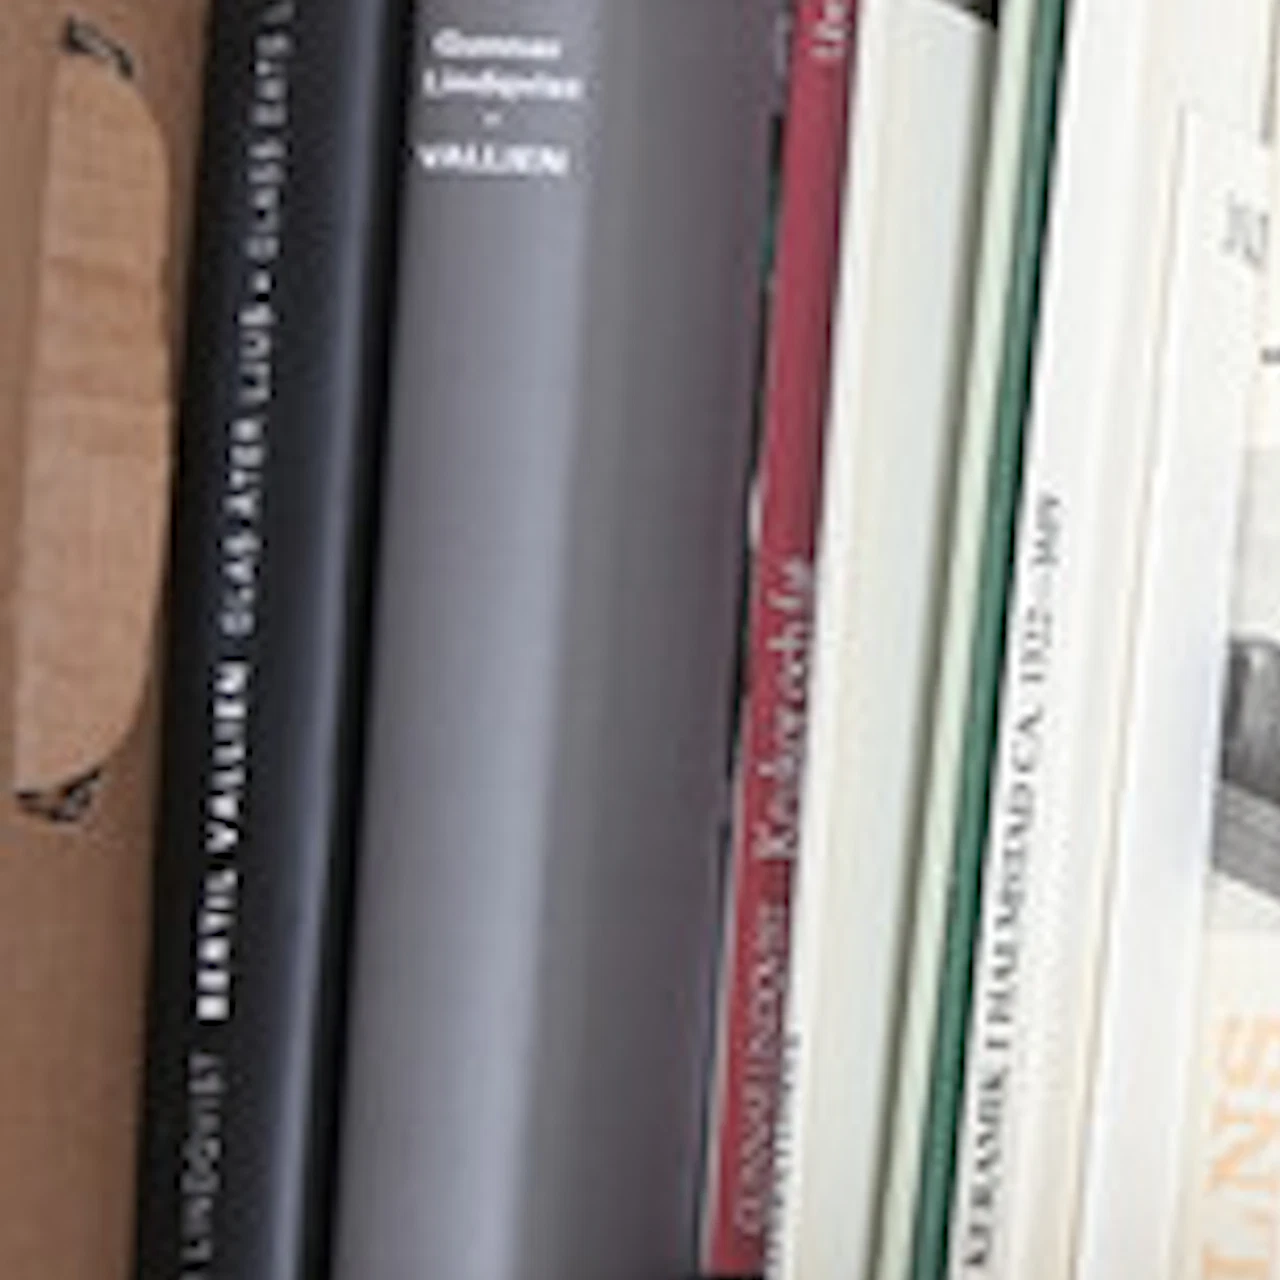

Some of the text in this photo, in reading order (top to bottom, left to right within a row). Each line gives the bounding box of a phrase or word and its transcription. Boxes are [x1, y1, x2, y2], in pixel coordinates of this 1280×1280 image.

[251, 31, 290, 125] EATS
[245, 140, 287, 262] GLASS
[417, 143, 571, 176] VALLIEN
[237, 306, 275, 407] LJUS
[219, 531, 262, 637] GLAS
[205, 660, 249, 854] VALLIEN
[198, 869, 238, 1021] BERTIL
[987, 783, 1036, 1026] HALMSTAD
[984, 1037, 1010, 1052] I
[182, 1053, 228, 1262] LINDQVIST
[962, 1068, 1008, 1272] KERAMIK
